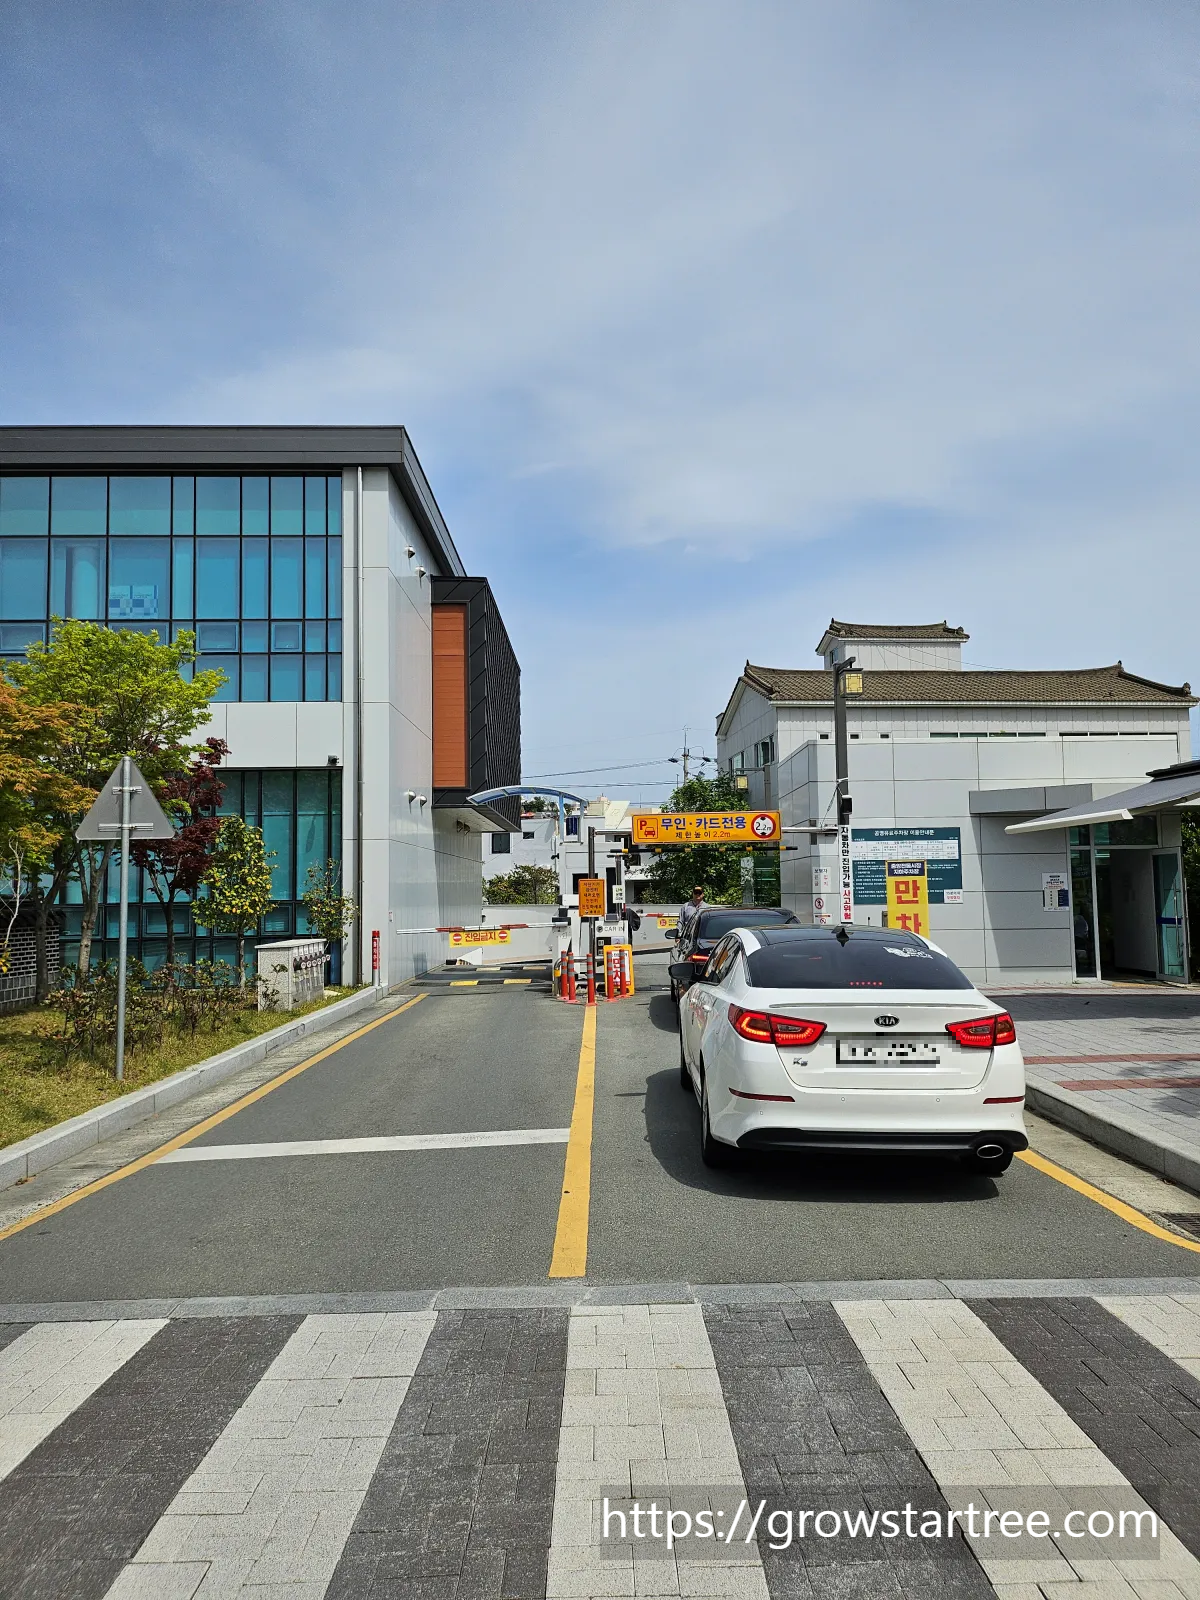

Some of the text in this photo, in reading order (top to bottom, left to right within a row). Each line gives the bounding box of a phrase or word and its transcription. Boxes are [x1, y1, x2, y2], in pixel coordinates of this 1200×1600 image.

[841, 827, 852, 920] 자동차만 진입가능 사고위험
[465, 931, 496, 943] 진입금지
[879, 1017, 896, 1026] KIA
